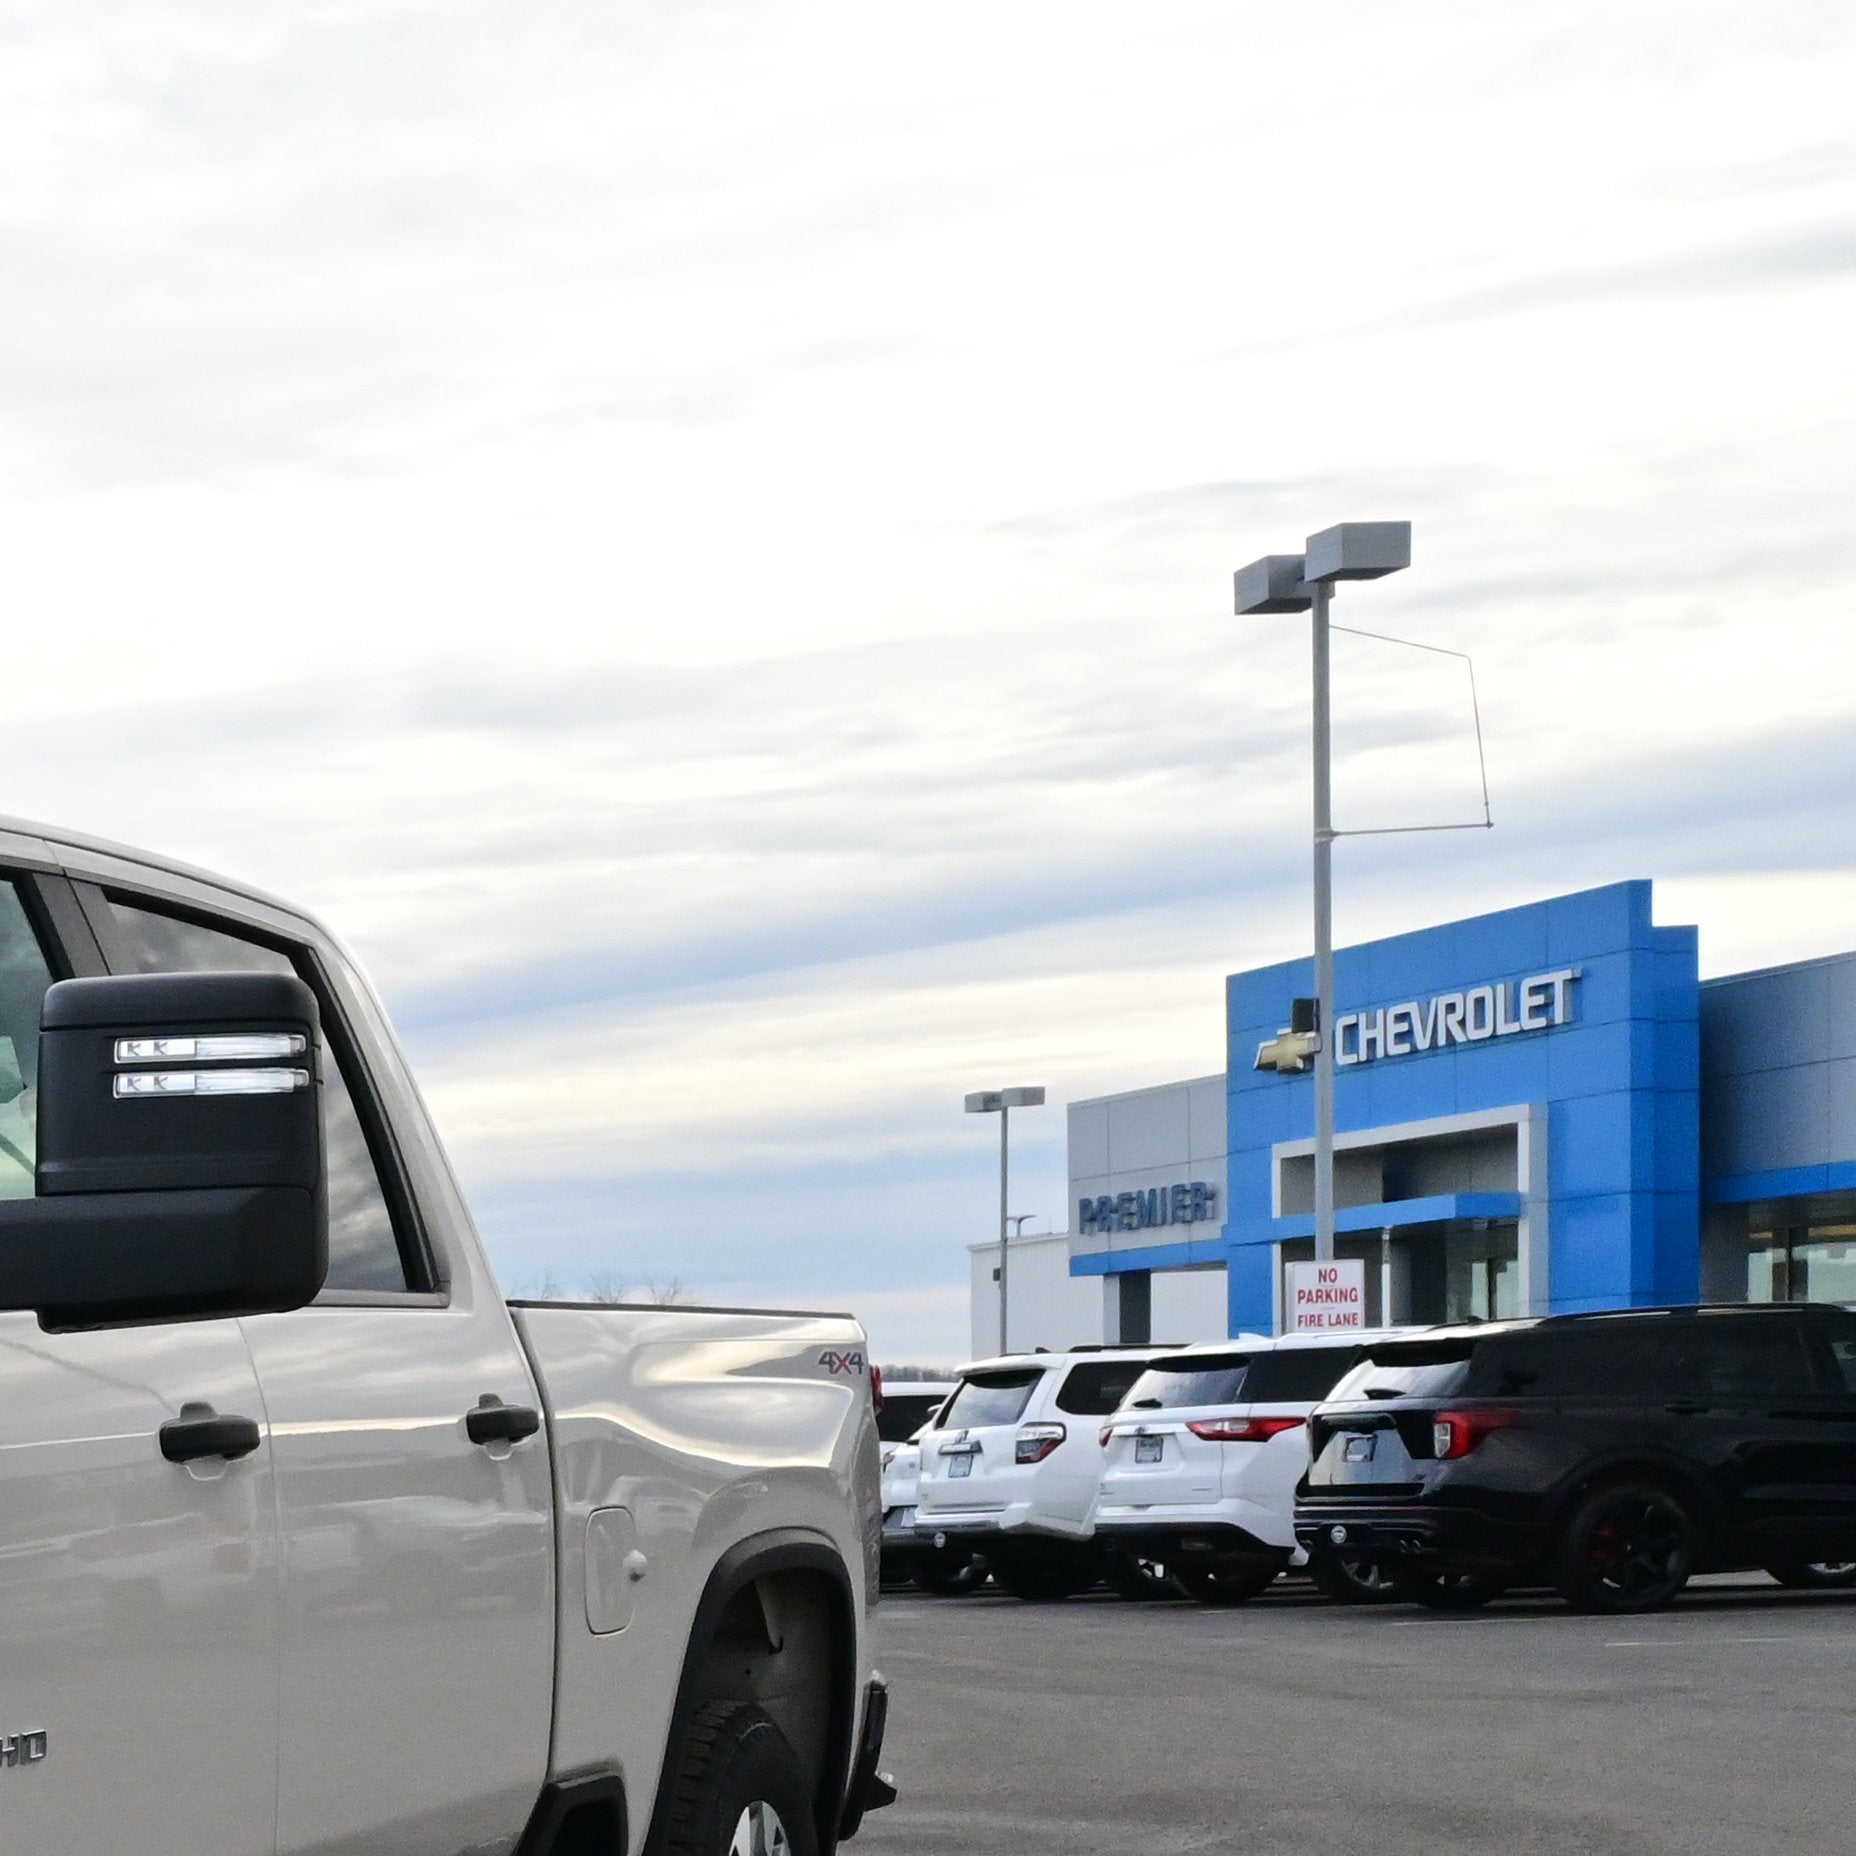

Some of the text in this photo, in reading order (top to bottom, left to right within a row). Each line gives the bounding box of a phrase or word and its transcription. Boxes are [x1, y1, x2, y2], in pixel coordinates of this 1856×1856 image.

[1335, 968, 1574, 1066] CHEVROLET
[1317, 1267, 1338, 1284] NO
[1297, 1288, 1359, 1305] PARKING
[1297, 1313, 1359, 1328] FIRE LANE
